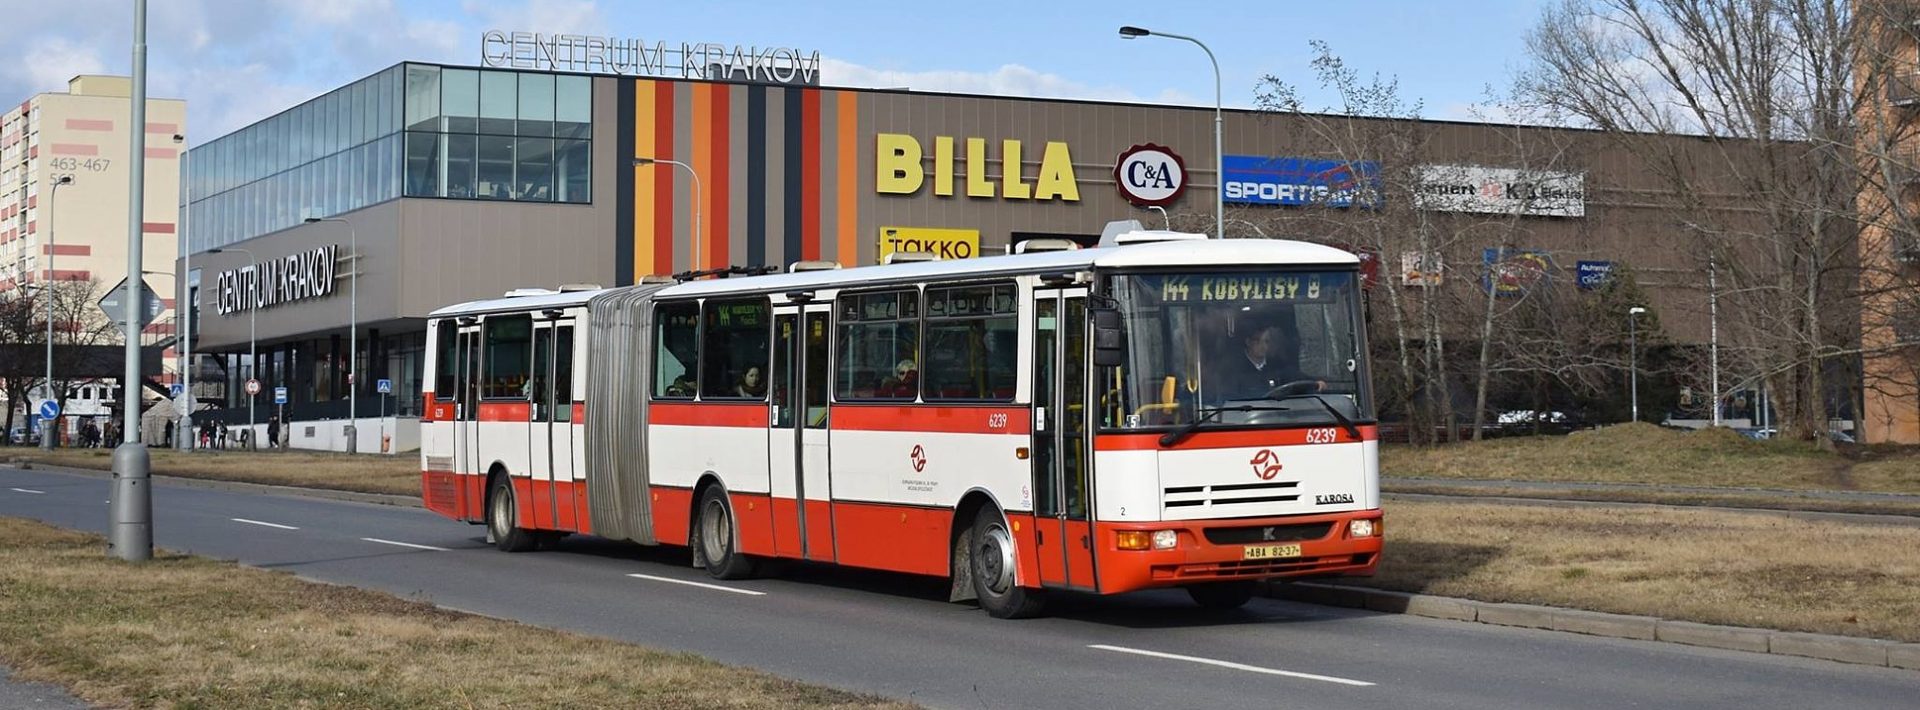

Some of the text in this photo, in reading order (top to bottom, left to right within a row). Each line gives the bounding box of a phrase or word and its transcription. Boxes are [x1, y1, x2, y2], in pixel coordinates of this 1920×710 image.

[482, 29, 820, 83] CENTRUM KRAKOV
[50, 157, 110, 171] 463-467
[876, 133, 1080, 201] BILLA
[1128, 160, 1175, 189] C&A
[216, 244, 337, 315] CENTRUM KRAKOV
[1162, 276, 1299, 301] 144 KOBYLISY
[988, 413, 1007, 429] 6239
[1306, 428, 1337, 444] 6239
[1315, 494, 1354, 505] KAROSA
[1120, 506, 1126, 516] 2
[1250, 545, 1296, 557] ABA 82-37
